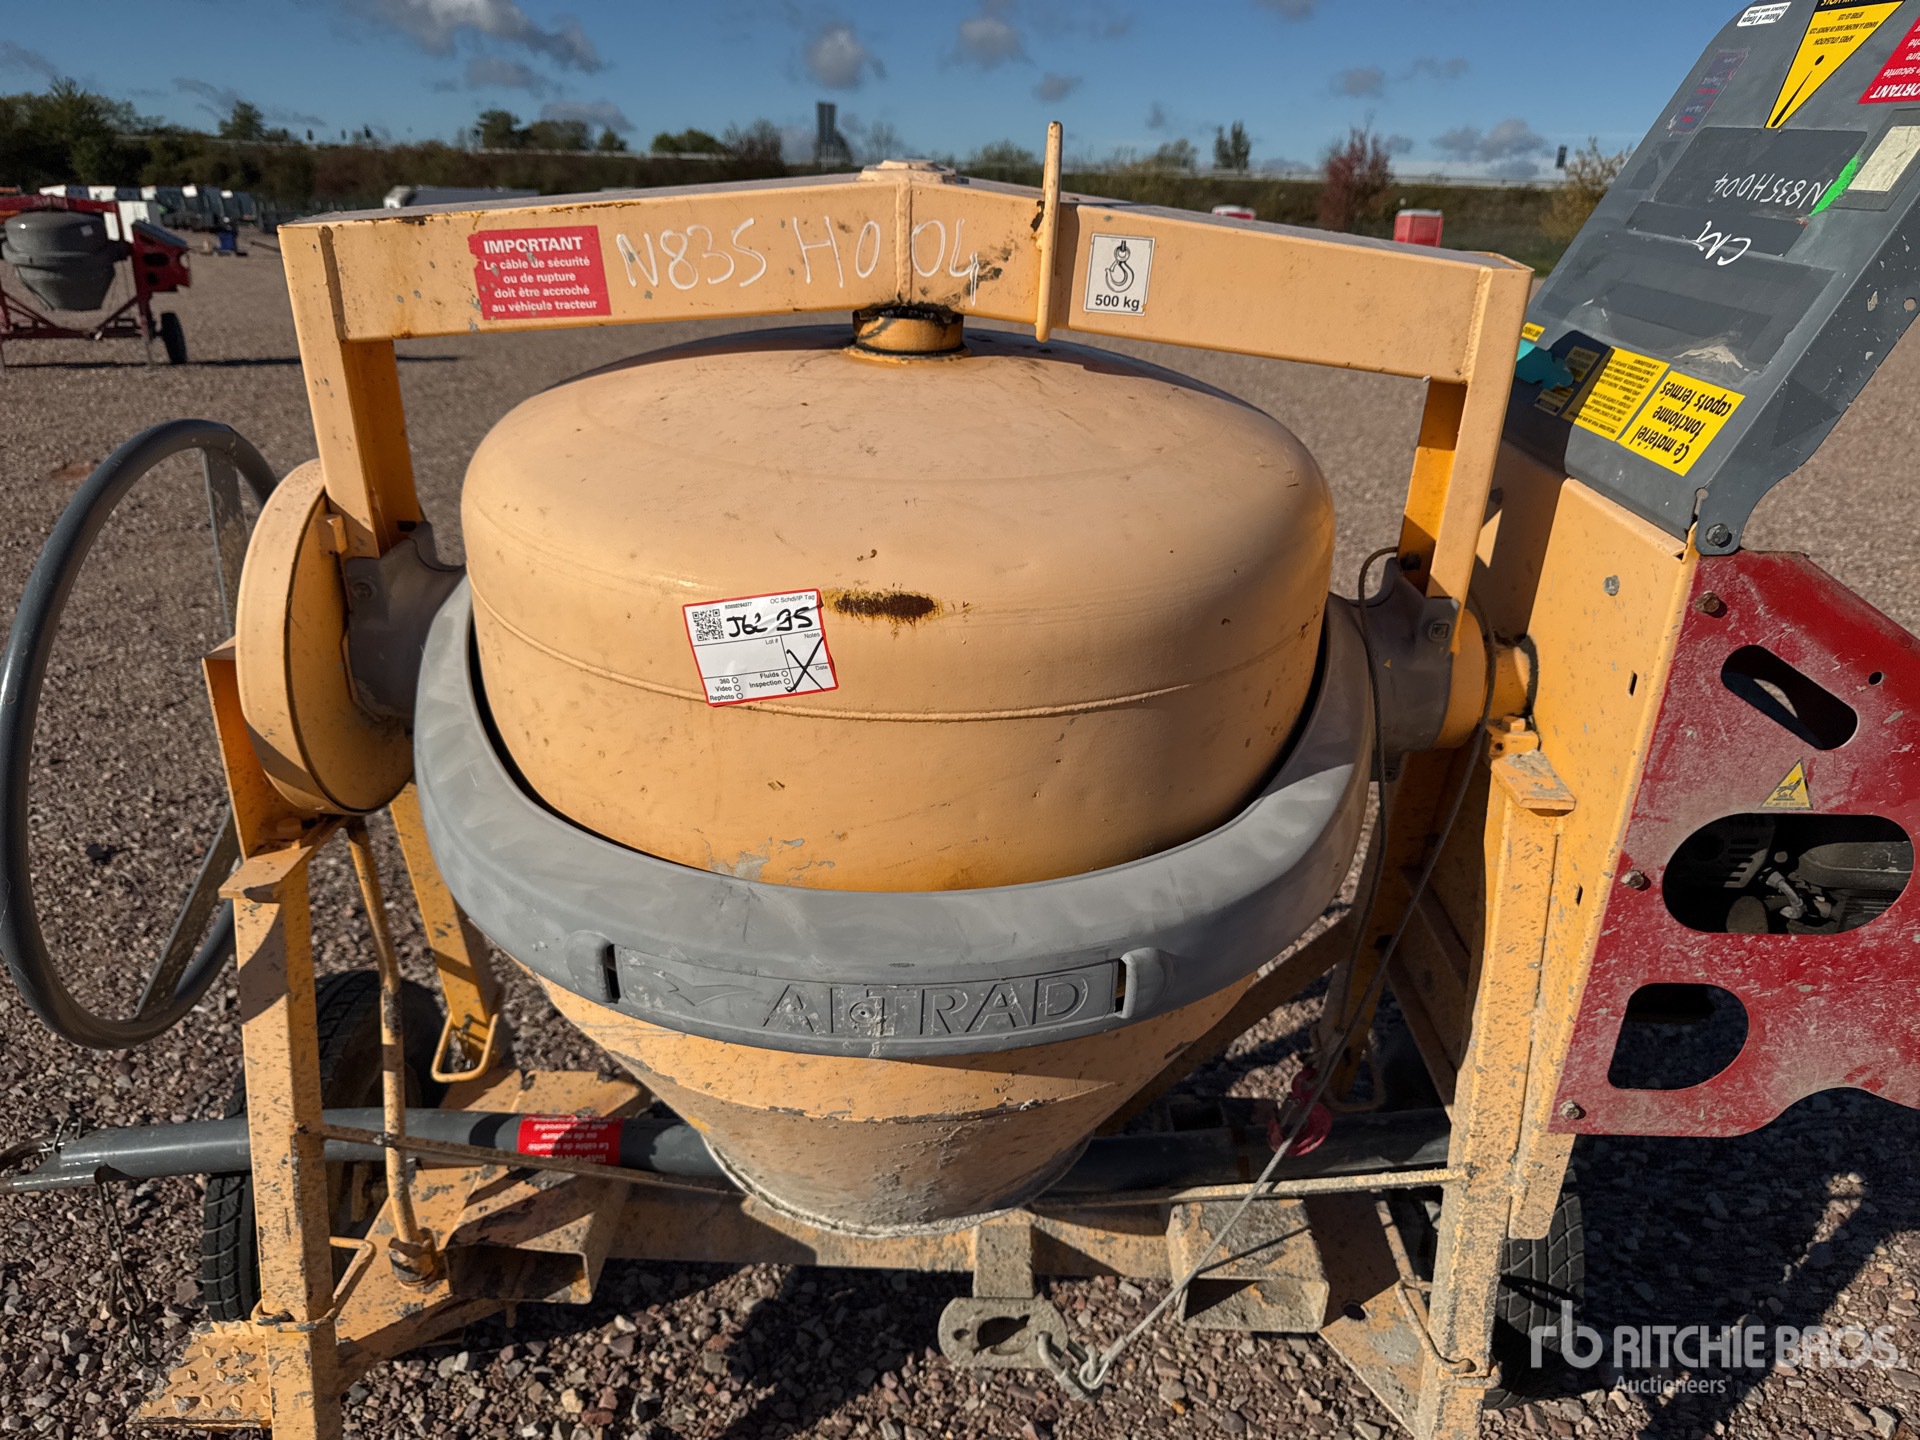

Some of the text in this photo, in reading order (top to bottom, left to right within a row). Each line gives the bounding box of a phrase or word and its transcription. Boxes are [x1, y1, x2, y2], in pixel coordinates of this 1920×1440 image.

[484, 236, 583, 254] IMPORTANT
[500, 258, 528, 270] câble
[531, 258, 545, 269] de
[547, 255, 590, 267] sécurité
[503, 272, 576, 284] ou de rupture
[494, 284, 590, 298] doit être accroché
[492, 300, 598, 312] au véhicule tracteur
[1095, 294, 1140, 311] 500 kg
[1659, 381, 1698, 411] fermés
[1693, 393, 1732, 417] capots
[1652, 405, 1706, 443] fonctionne
[1629, 425, 1690, 464] Ce matériel
[804, 594, 816, 602] Tag
[804, 632, 820, 640] Notes
[749, 679, 782, 688] Inspection
